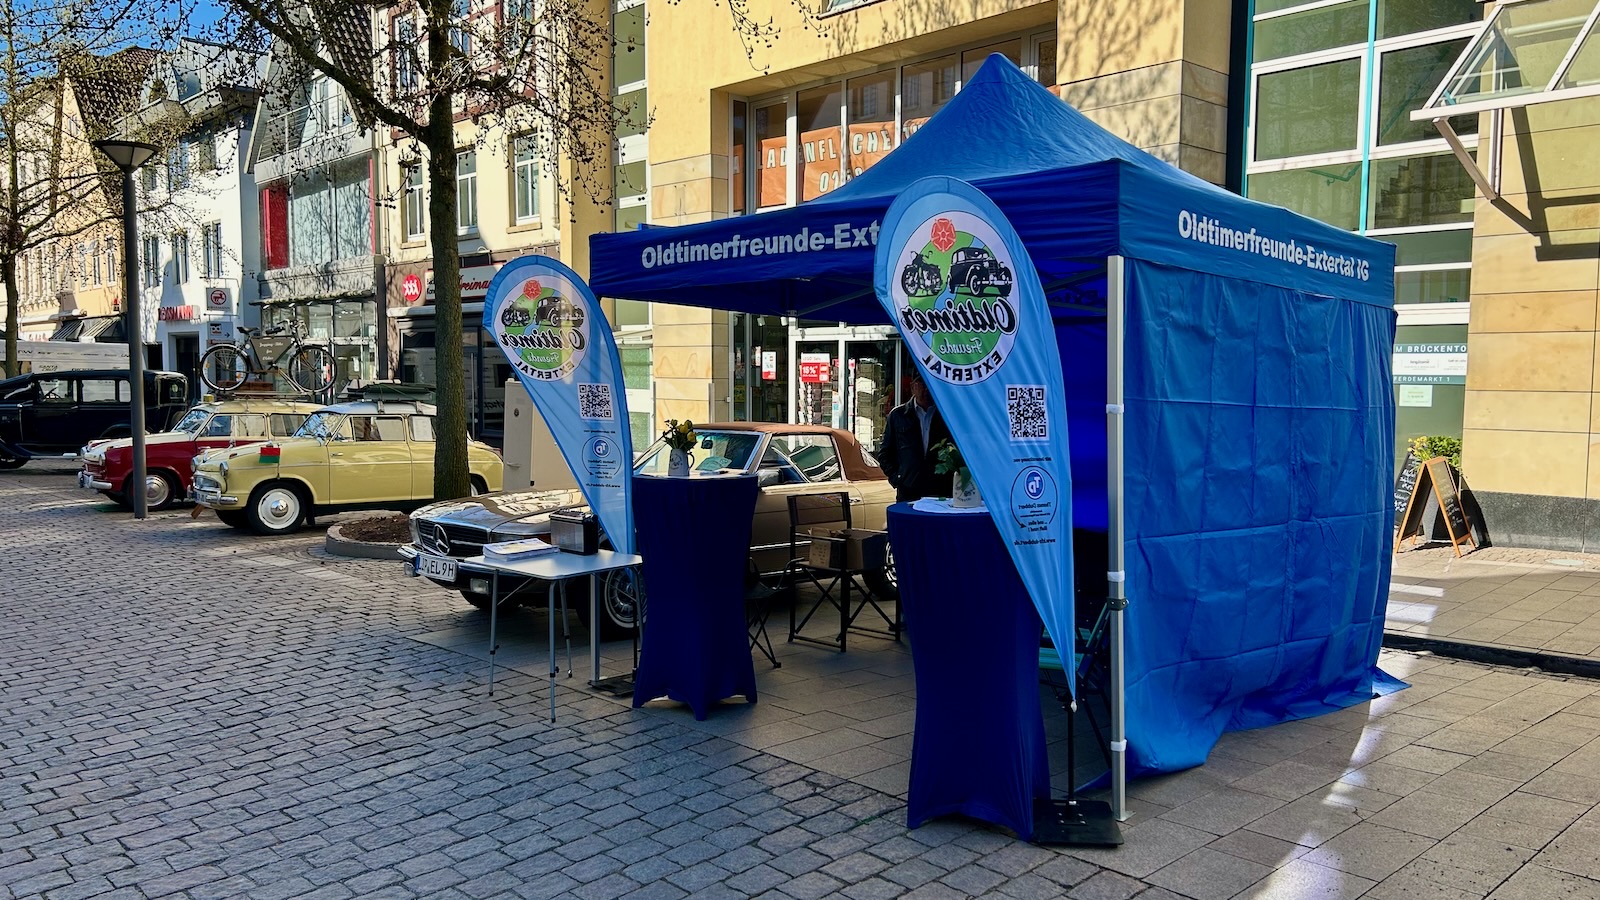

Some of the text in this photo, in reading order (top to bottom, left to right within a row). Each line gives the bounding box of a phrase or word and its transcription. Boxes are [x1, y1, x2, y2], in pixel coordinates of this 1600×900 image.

[641, 219, 880, 269] Oldtimerfreunde-Ext
[1178, 209, 1370, 282] Oldtimerfreunde-Extertal IG
[1407, 344, 1467, 353] BRÜCKENTO
